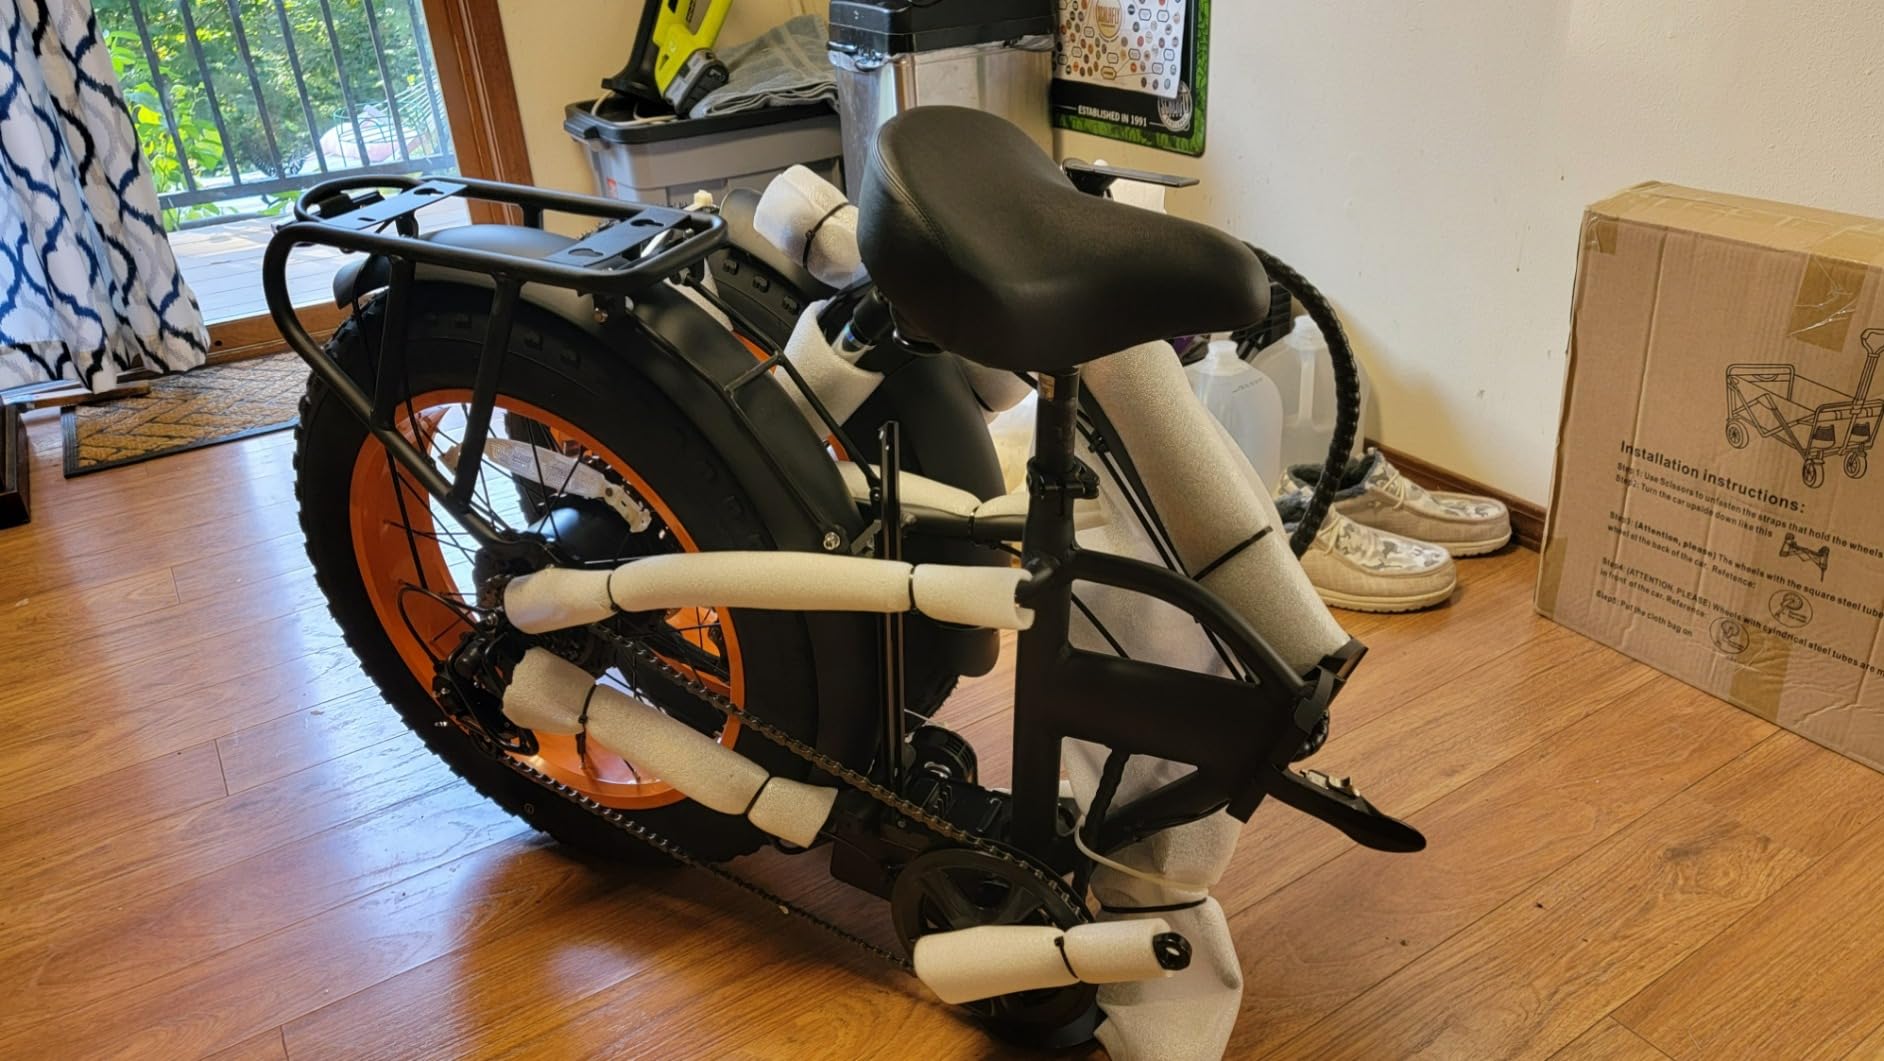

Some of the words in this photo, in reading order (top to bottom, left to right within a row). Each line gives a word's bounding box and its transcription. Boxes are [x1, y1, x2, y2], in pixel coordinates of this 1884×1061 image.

[1078, 105, 1120, 122] ESTABLISHED
[1121, 114, 1129, 123] IN
[1131, 115, 1147, 127] 1991
[1620, 440, 1699, 479] Installation
[1703, 469, 1805, 513] instructions:
[1641, 482, 1658, 495] Turn
[1659, 491, 1671, 501] the
[1672, 496, 1686, 506] car
[1686, 502, 1714, 516] upside
[1715, 511, 1737, 525] down
[1738, 518, 1754, 532] like
[1755, 526, 1773, 537] this
[1644, 472, 1658, 483] Use
[1660, 478, 1694, 496] Scissors
[1695, 490, 1704, 500] to
[1705, 496, 1741, 514] unfasten
[1742, 508, 1756, 518] the
[1758, 513, 1787, 528] straps
[1788, 523, 1808, 535] that
[1809, 528, 1831, 542] hold
[1832, 536, 1847, 547] the
[1849, 542, 1884, 559] wheels
[1638, 536, 1651, 546] the
[1671, 550, 1680, 558] of
[1681, 553, 1693, 563] the
[1638, 584, 1650, 593] the
[1719, 554, 1733, 566] The
[1735, 563, 1764, 577] wheels
[1767, 573, 1786, 585] with
[1787, 579, 1802, 590] the
[1803, 585, 1836, 602] square
[1837, 597, 1861, 611] steel
[1667, 620, 1682, 634] bag
[1683, 628, 1693, 637] on
[1713, 604, 1742, 622] Wheels
[1743, 616, 1761, 629] with
[1808, 641, 1831, 655] steel
[1832, 650, 1858, 666] tubes
[1860, 662, 1875, 673] are
